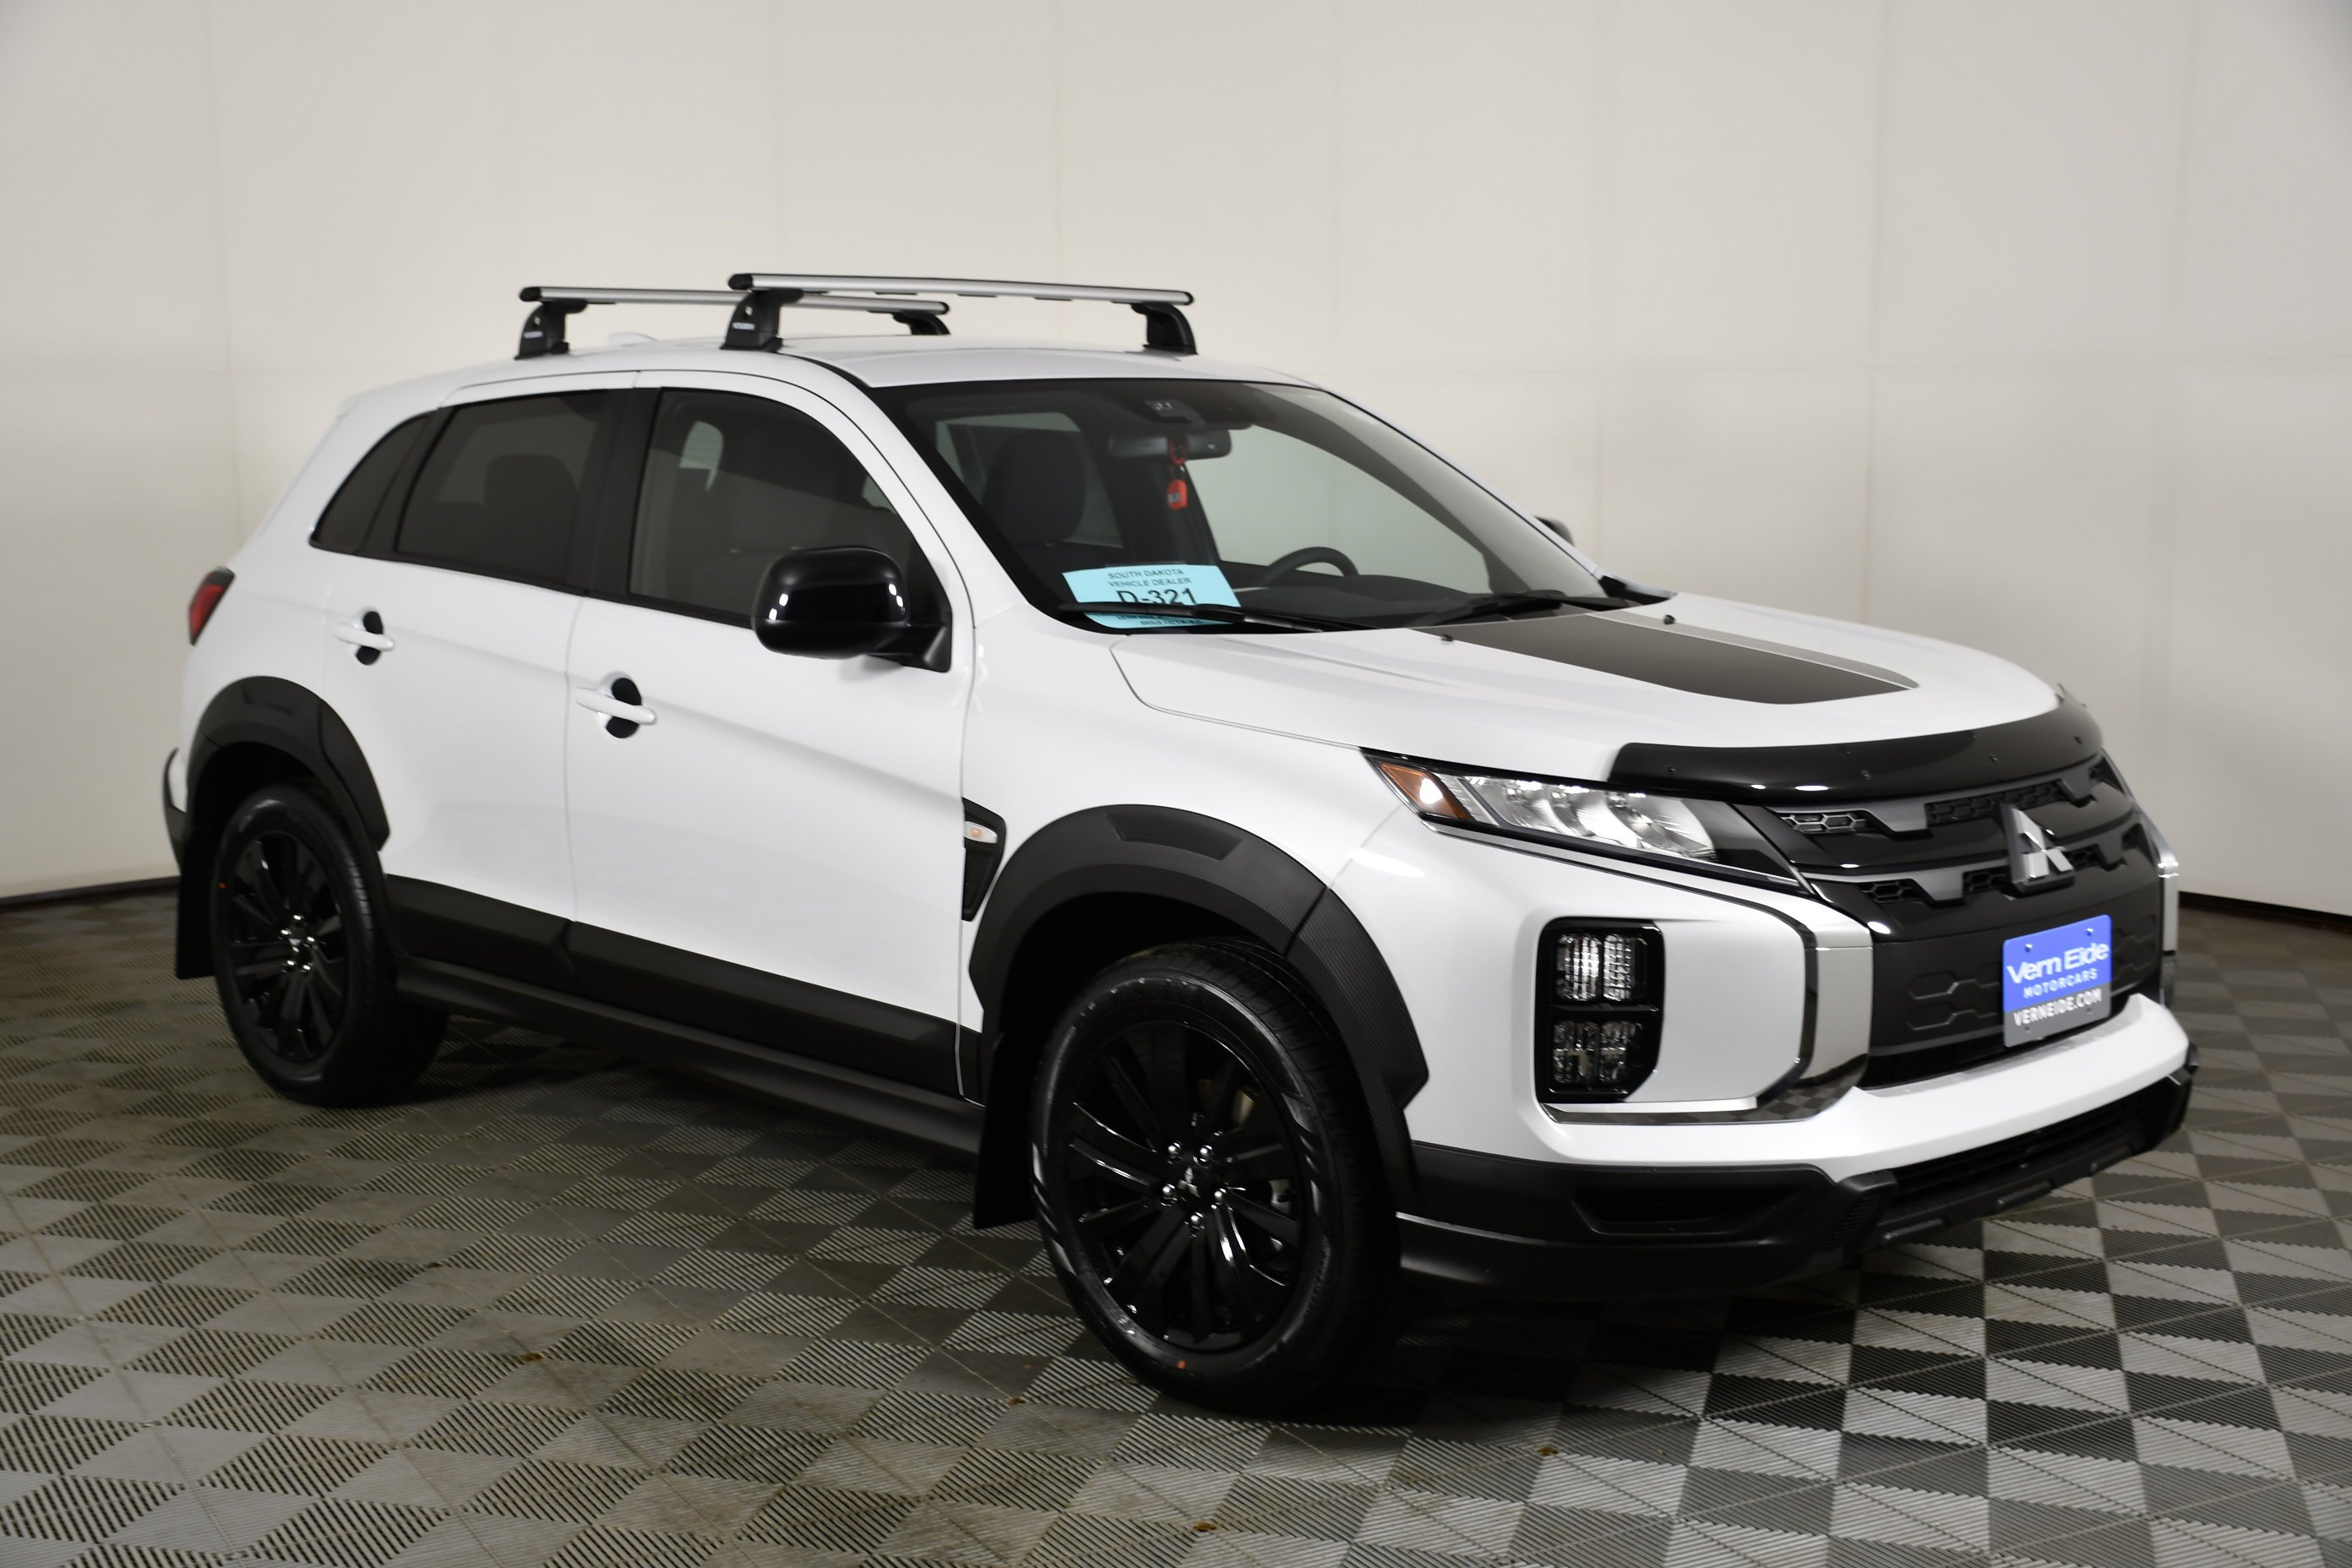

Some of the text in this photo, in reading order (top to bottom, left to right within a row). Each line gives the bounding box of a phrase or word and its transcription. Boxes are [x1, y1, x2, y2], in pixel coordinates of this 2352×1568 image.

[1108, 569, 1184, 580] SOUTH DAKOTA
[1108, 577, 1192, 588] VEHICLE DEALER
[1116, 587, 1199, 606] D-321
[2006, 942, 2110, 984] Vern Eide
[2023, 968, 2099, 999] MOTORCARS
[2012, 988, 2102, 1026] VERNEIDE.COM
